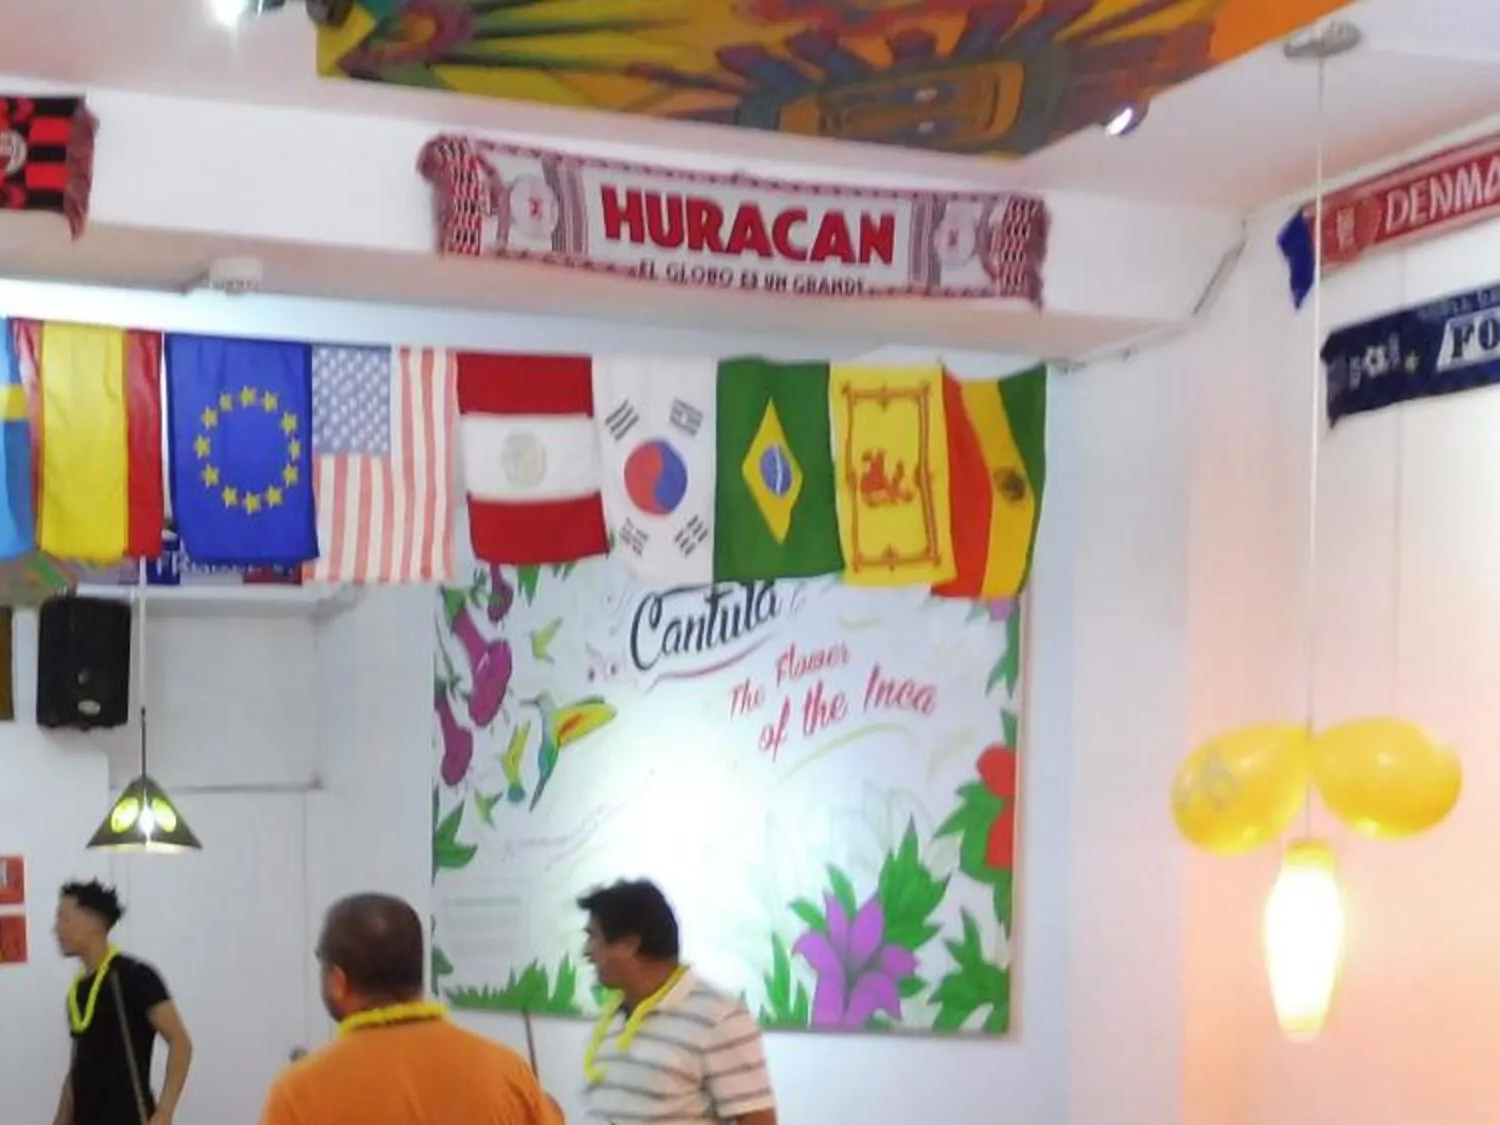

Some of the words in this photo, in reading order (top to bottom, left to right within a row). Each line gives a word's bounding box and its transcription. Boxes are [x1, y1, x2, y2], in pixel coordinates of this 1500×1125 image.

[601, 184, 896, 266] HURACAN
[758, 695, 791, 763] of
[803, 679, 848, 737] the
[863, 663, 938, 715] Inca
